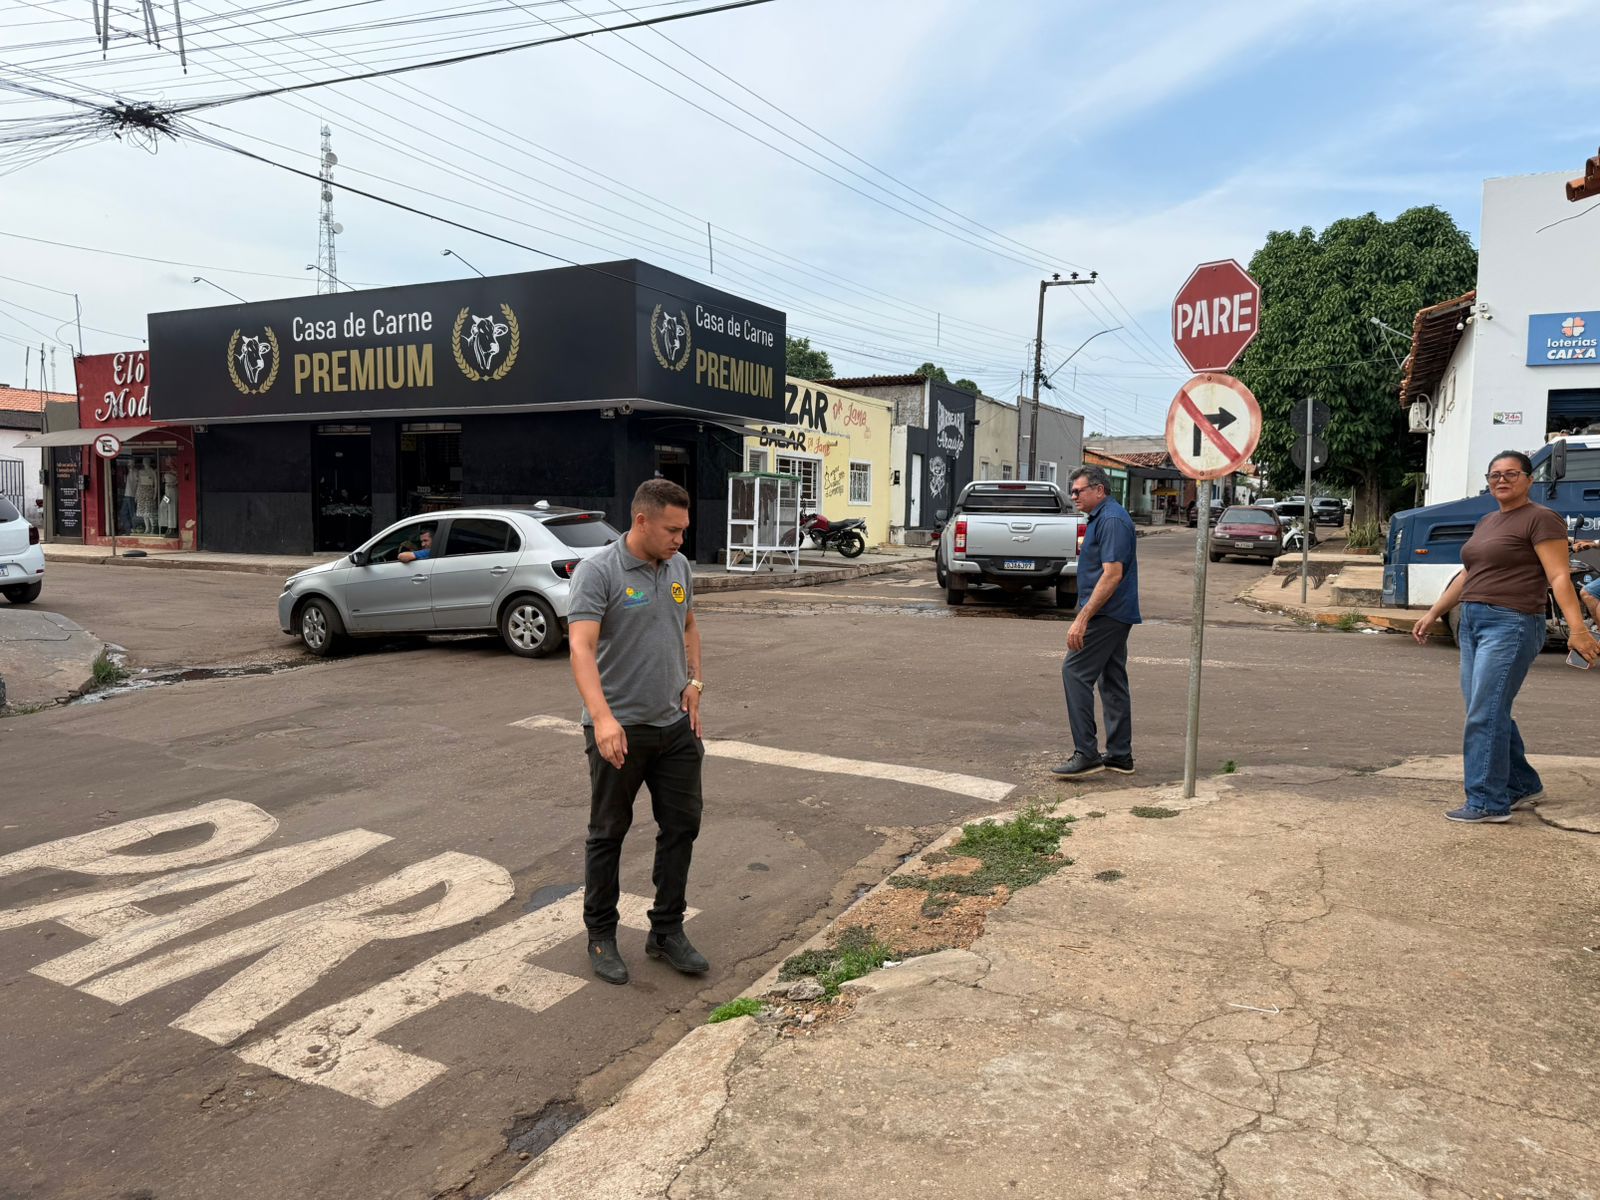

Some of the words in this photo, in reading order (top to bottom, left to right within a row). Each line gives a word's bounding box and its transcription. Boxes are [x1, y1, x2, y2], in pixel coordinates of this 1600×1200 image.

[292, 316, 337, 341] Casa
[343, 312, 366, 337] de
[373, 309, 433, 336] Carne
[696, 305, 724, 334] Casa
[728, 315, 741, 338] de
[744, 320, 774, 347] Carne
[1177, 292, 1252, 340] PARE
[1546, 348, 1597, 359] CAIXA
[1547, 338, 1597, 348] loterias
[113, 353, 146, 385] Elô
[294, 343, 434, 394] PREMIUM
[696, 348, 773, 399] PREMIUM
[95, 385, 151, 422] Mod
[785, 383, 828, 433] ZAR
[0, 798, 702, 1109] PARE
